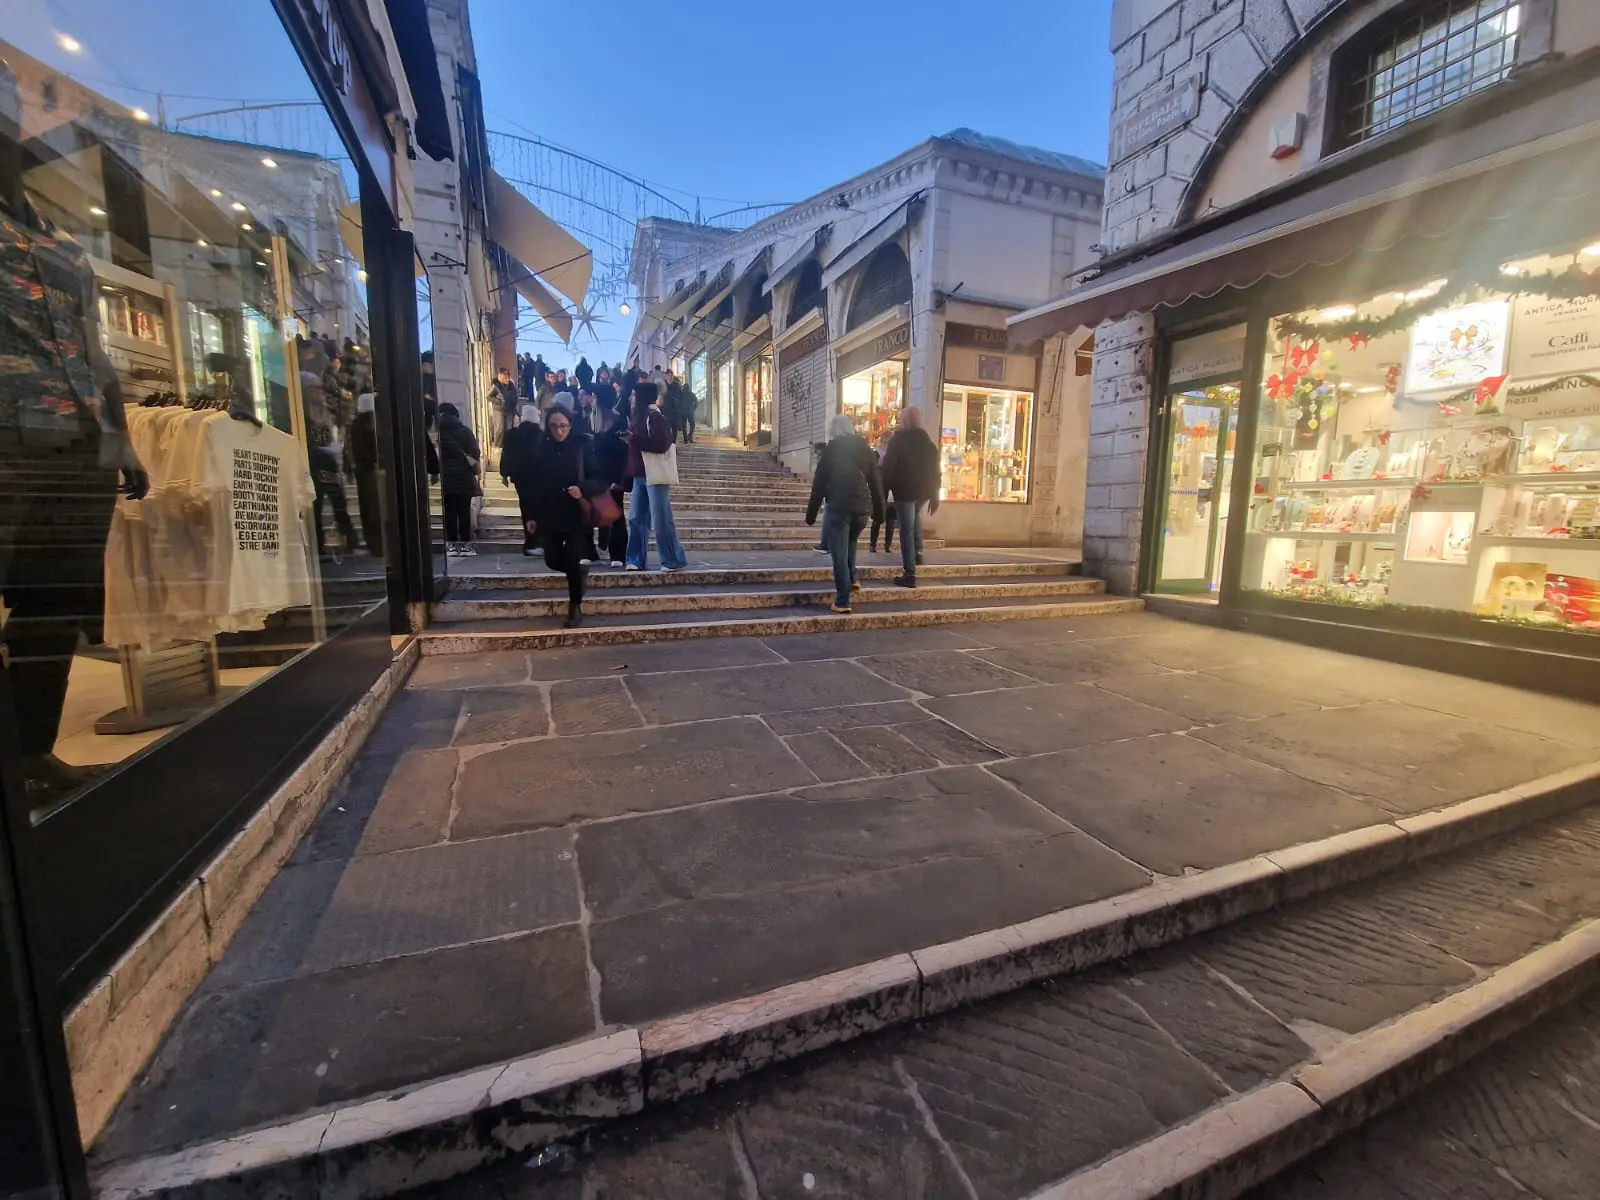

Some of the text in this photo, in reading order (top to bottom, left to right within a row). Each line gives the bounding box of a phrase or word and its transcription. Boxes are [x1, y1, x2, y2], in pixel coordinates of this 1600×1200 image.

[873, 327, 908, 356] FRANCO
[233, 469, 252, 480] HARD
[233, 490, 255, 501] BOOTY
